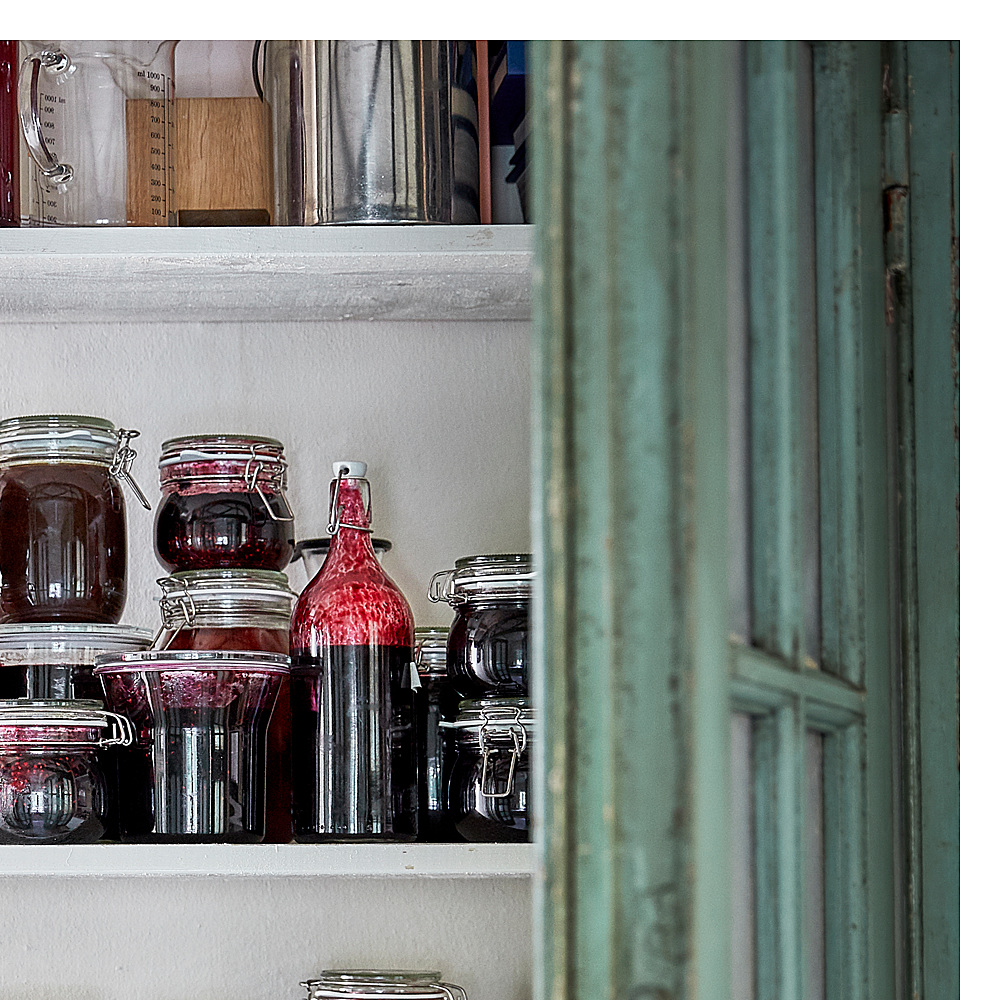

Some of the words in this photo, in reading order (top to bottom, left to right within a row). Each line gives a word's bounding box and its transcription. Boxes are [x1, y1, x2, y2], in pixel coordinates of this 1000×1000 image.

[147, 71, 160, 80] 1000
[150, 84, 160, 92] 900
[150, 100, 160, 108] 800
[150, 115, 160, 124] 700
[150, 147, 160, 155] 500
[150, 163, 160, 171] 400
[150, 179, 161, 187] 300
[150, 195, 161, 203] 200
[151, 208, 161, 216] 100
